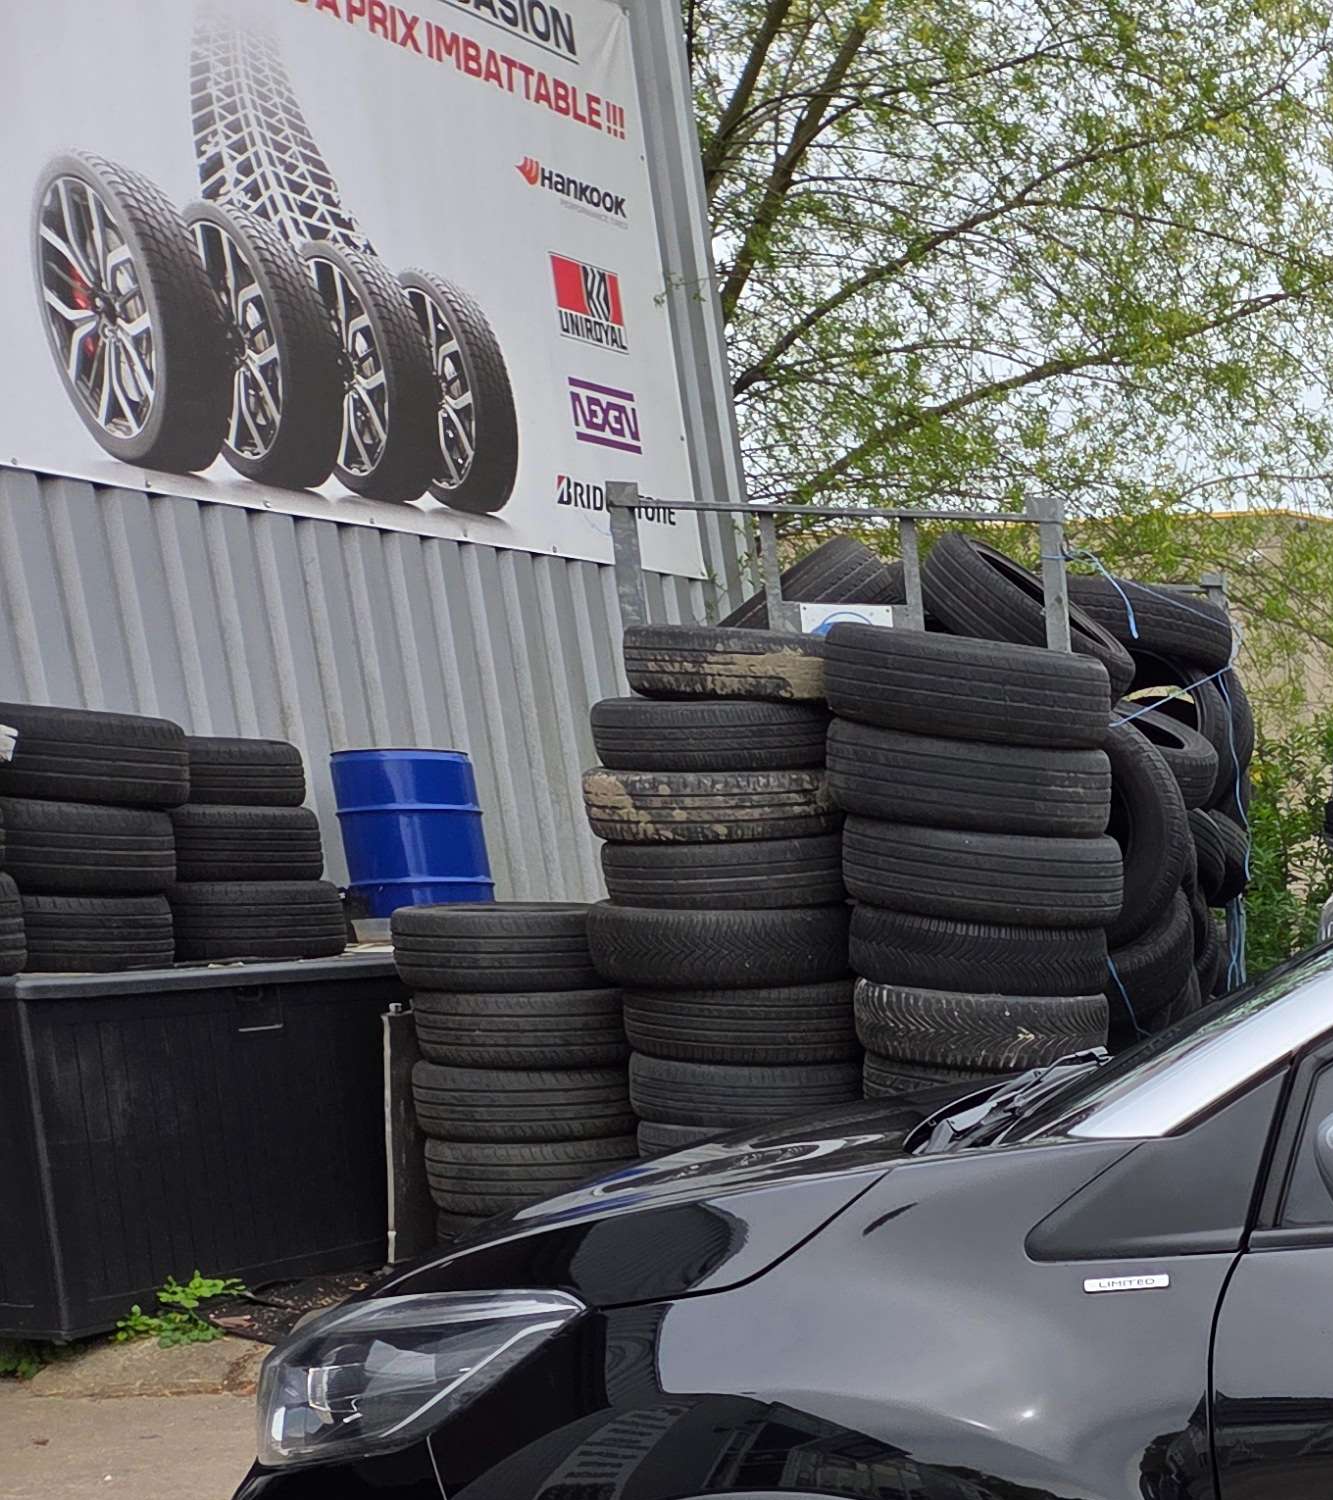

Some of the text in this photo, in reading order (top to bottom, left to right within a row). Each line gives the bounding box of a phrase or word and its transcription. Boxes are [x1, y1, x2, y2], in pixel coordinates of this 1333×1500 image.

[346, 0, 422, 54] PRIX
[425, 20, 602, 130] IMBATTABLE
[559, 310, 628, 351] UNIROYAL
[569, 390, 641, 443] NEXEN
[1098, 1278, 1155, 1289] LIMITED
